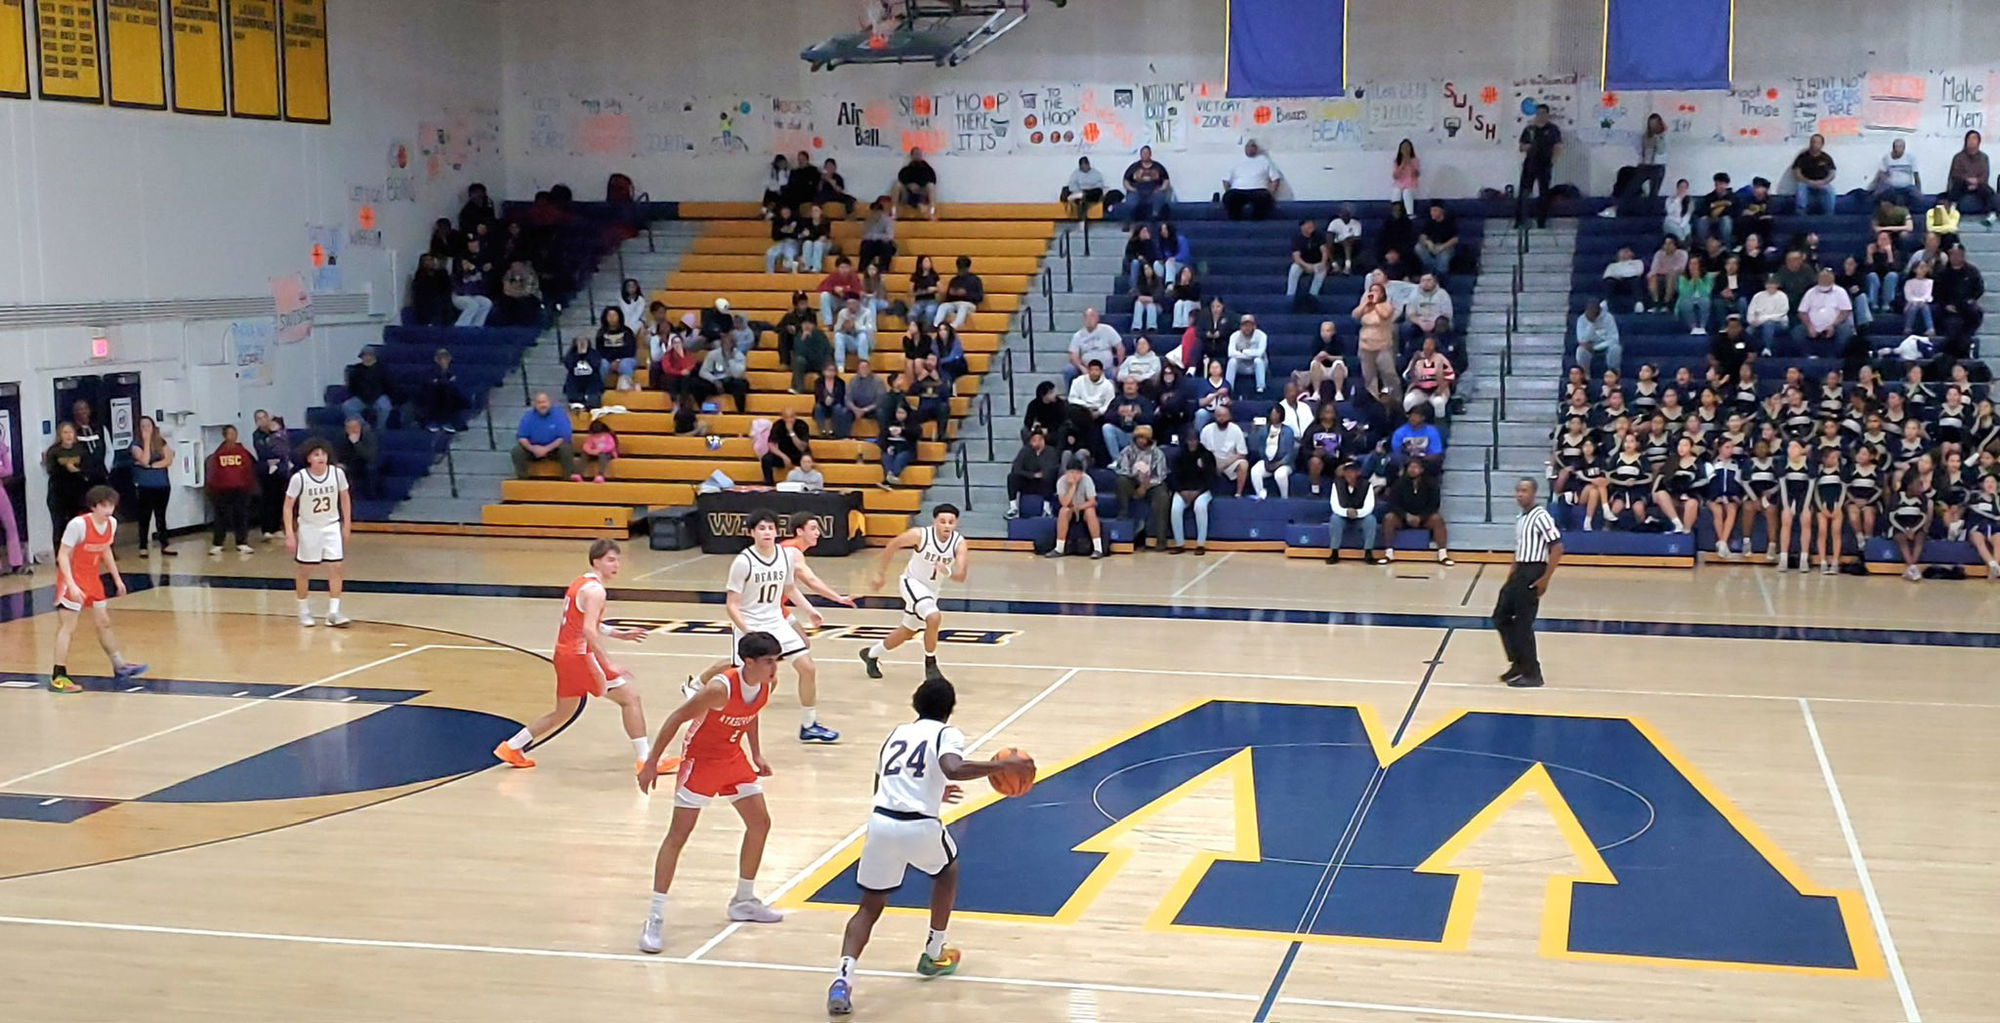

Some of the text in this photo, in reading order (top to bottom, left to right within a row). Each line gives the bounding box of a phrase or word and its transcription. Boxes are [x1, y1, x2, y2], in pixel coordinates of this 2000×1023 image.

[1047, 88, 1061, 98] TO
[1142, 83, 1185, 102] NOTHING
[1942, 76, 1984, 102] Make
[956, 92, 1009, 112] HOOP
[1044, 99, 1063, 109] THE
[1196, 101, 1242, 112] VICTORY
[1443, 82, 1496, 140] SWISH
[837, 101, 864, 126] Air
[955, 112, 990, 130] THERE
[1042, 108, 1077, 126] HOOP
[1201, 115, 1231, 128] ZONE
[1942, 104, 1983, 128] Them
[855, 126, 880, 147] Ball
[957, 133, 973, 151] IT
[979, 133, 997, 151] IS
[219, 454, 242, 467] USC
[308, 485, 335, 496] BEARS
[312, 496, 331, 514] 23
[707, 513, 834, 538] WARN
[924, 551, 953, 565] BEARS
[754, 570, 785, 583] BEARS
[757, 584, 778, 603] 10
[729, 729, 741, 743] 2
[883, 739, 928, 778] 24
